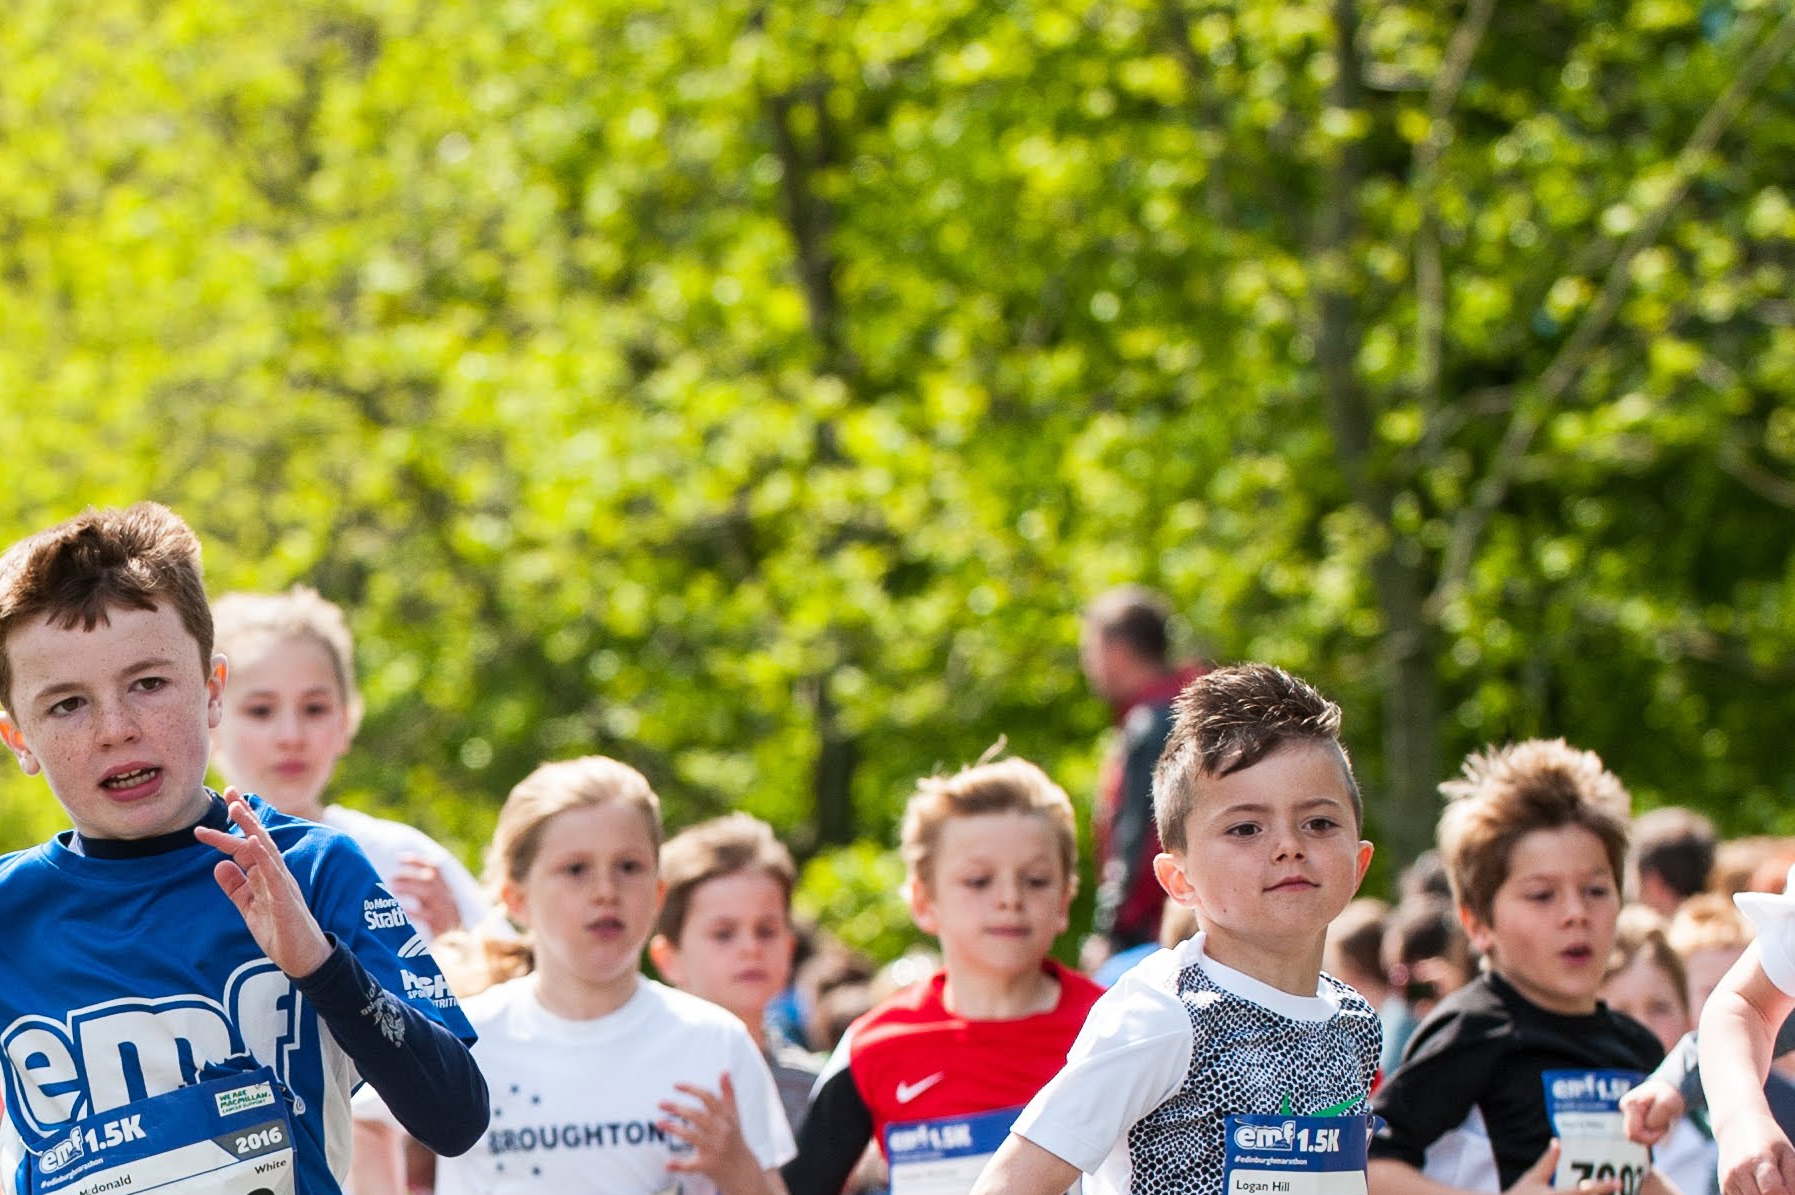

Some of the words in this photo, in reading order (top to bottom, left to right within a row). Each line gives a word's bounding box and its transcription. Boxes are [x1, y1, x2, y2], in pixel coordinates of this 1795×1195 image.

[0, 957, 302, 1137] emf
[38, 1125, 84, 1174] emf
[85, 1114, 147, 1153] 1.5K
[235, 1126, 283, 1155] 2016
[1233, 1120, 1296, 1152] emf
[1297, 1128, 1340, 1153] 1.5K
[254, 1160, 287, 1175] White
[1236, 1180, 1269, 1194] Logan
[1272, 1181, 1291, 1193] Hill
